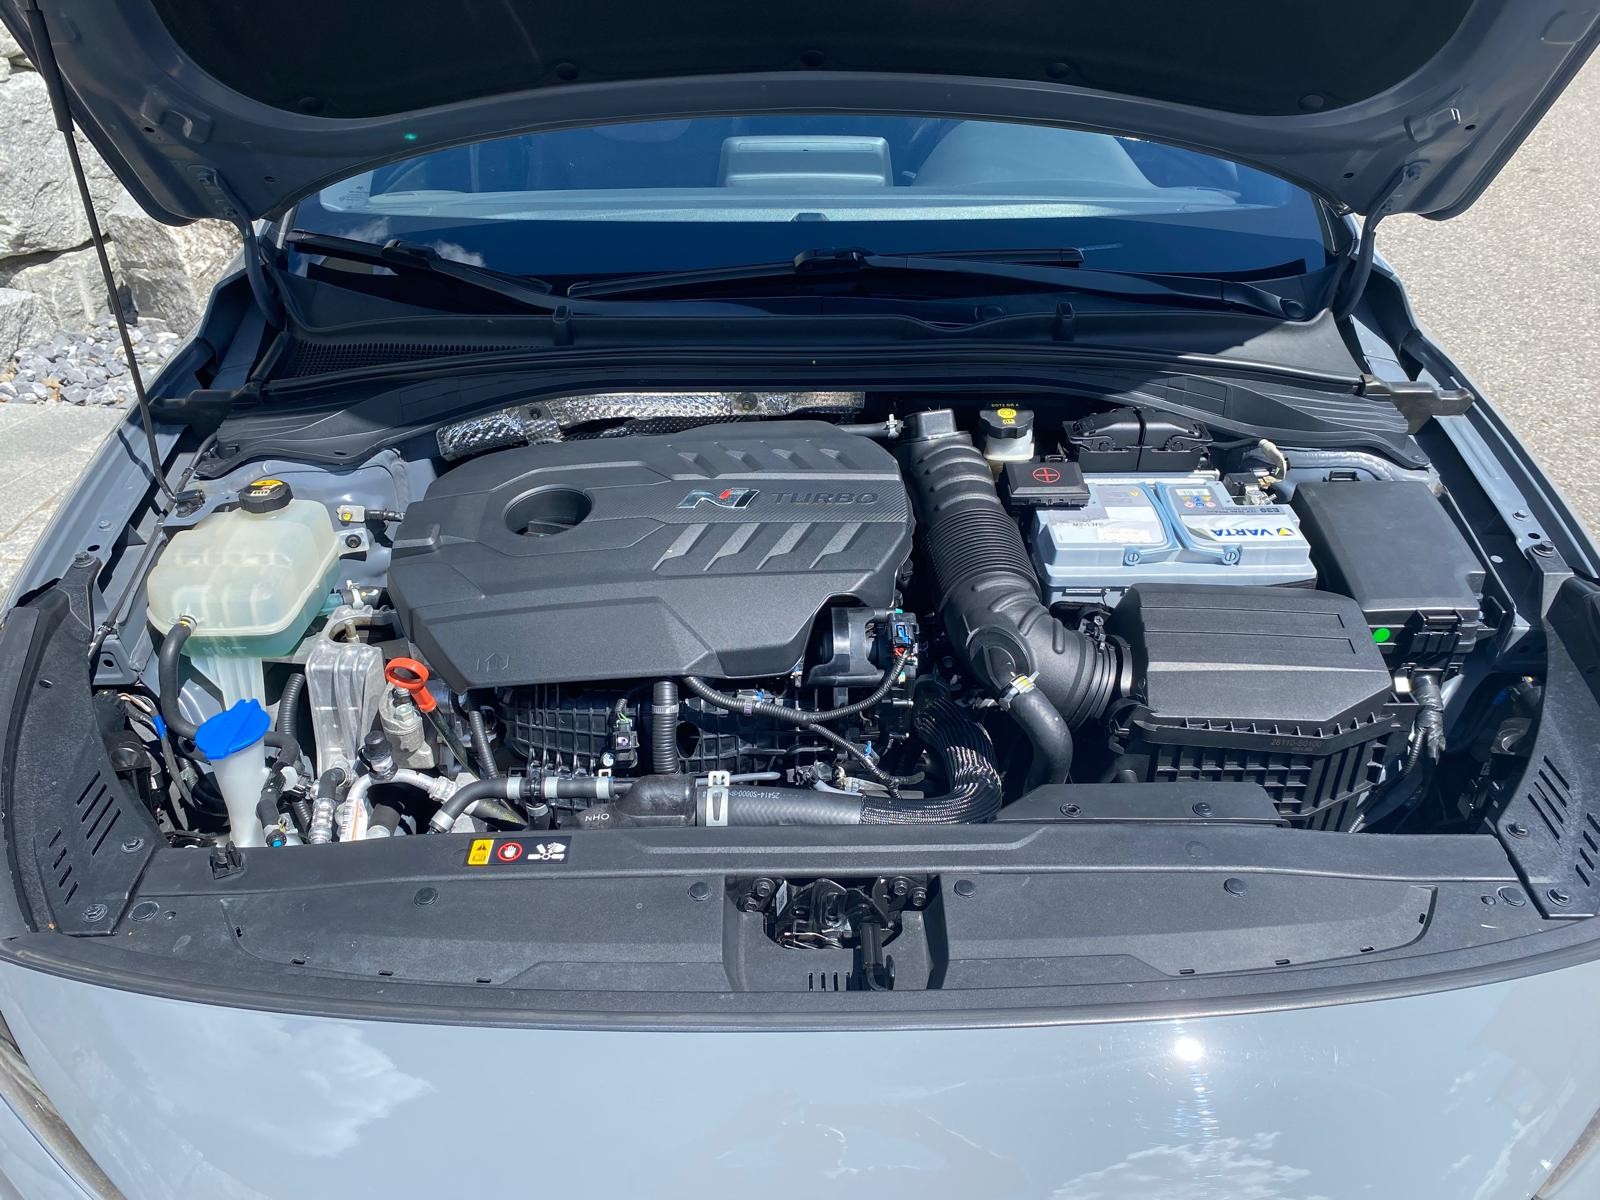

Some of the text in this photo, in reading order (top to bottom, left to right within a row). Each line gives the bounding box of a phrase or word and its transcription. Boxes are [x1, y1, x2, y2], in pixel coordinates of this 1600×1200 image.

[771, 491, 880, 505] TURBO
[1210, 527, 1273, 538] VARTA
[584, 813, 610, 822] NHO
